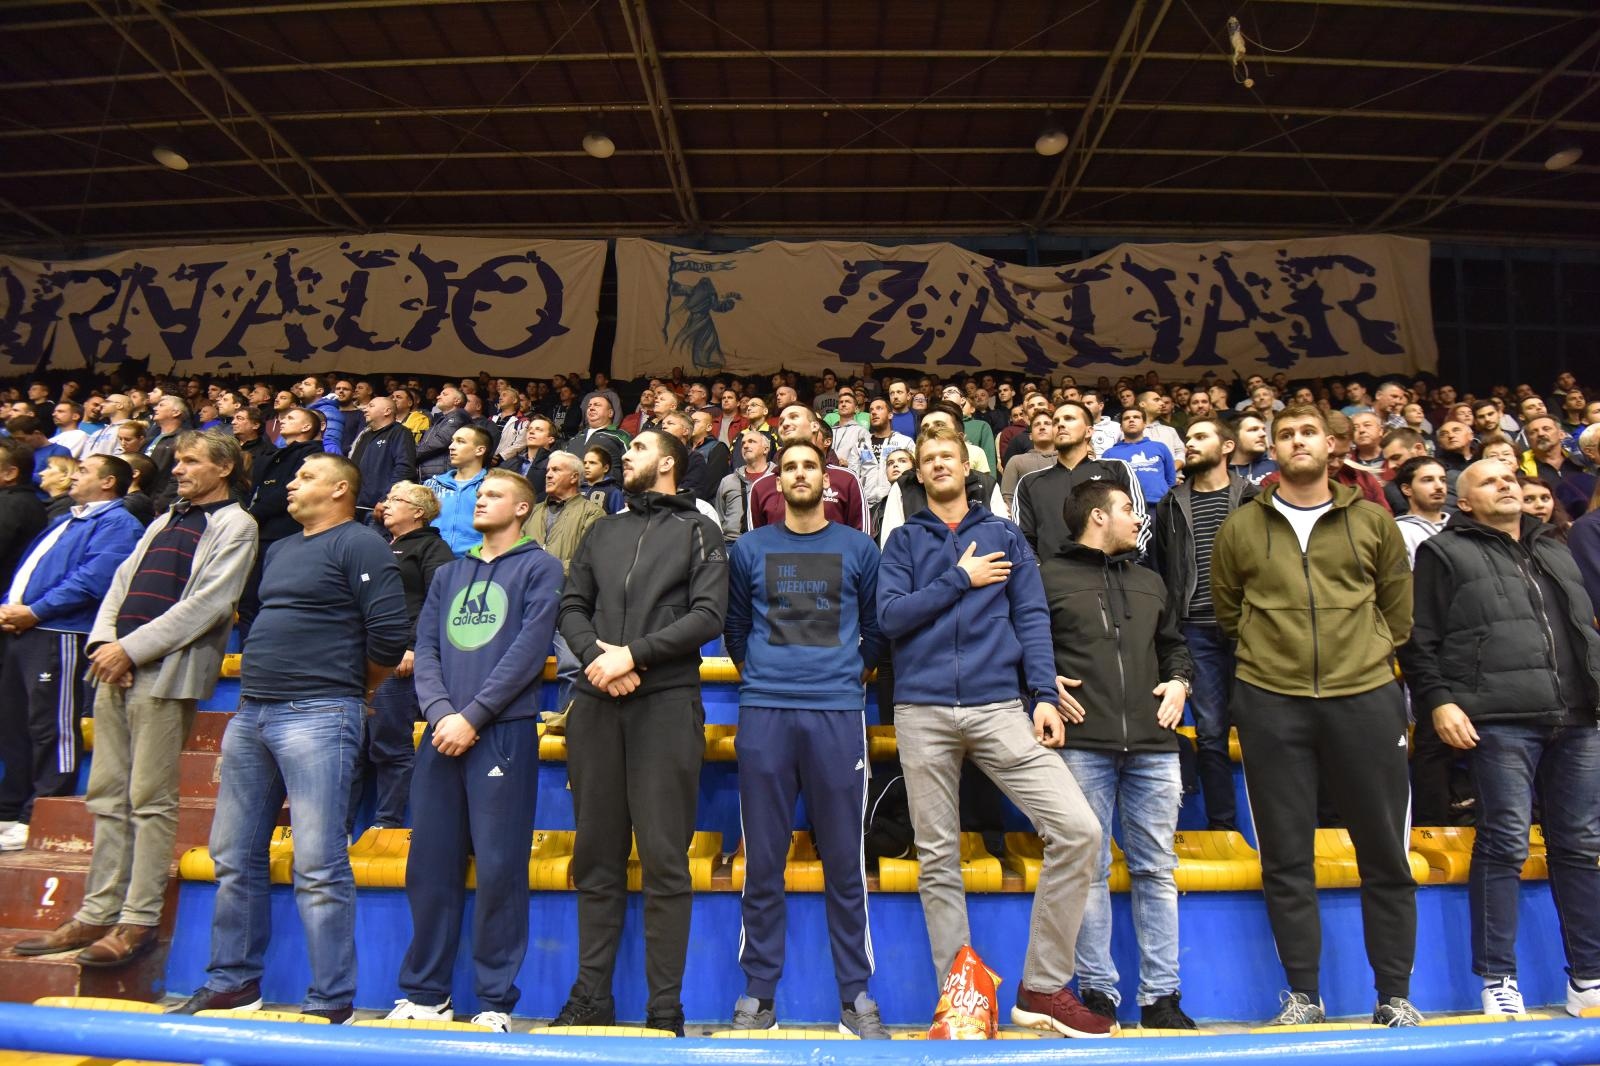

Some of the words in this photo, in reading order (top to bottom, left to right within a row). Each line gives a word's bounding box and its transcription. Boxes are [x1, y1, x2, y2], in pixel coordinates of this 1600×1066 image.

[0, 242, 570, 366] RNADO
[818, 249, 1406, 374] ZADAR
[776, 564, 798, 577] THE
[776, 580, 828, 593] WEEKEND
[452, 612, 496, 626] adidas
[41, 877, 59, 906] 2
